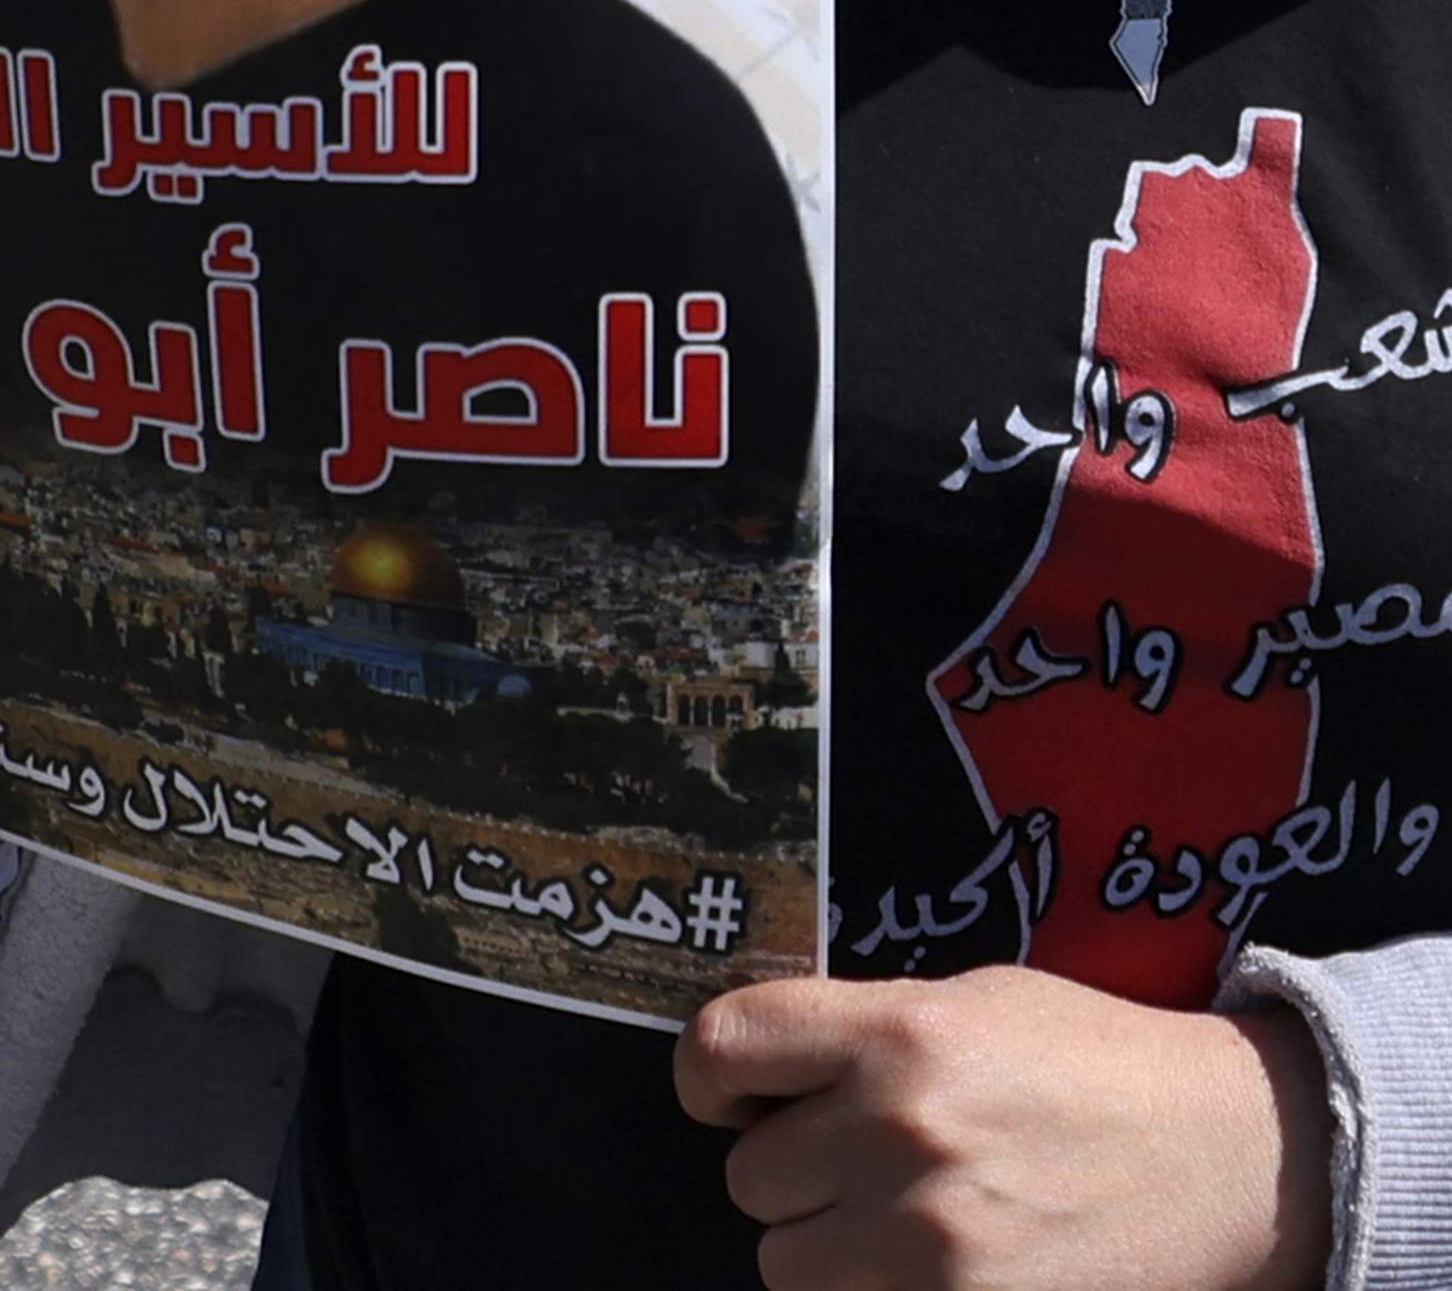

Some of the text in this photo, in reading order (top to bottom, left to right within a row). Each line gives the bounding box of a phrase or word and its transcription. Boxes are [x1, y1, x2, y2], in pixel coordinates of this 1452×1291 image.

[92, 43, 479, 203] للأسير
[21, 223, 264, 473] أبو
[320, 292, 731, 495] ناصر
[939, 362, 1177, 492] واحد
[958, 604, 1176, 711] واحد
[122, 769, 437, 900] الاحتلال
[1104, 776, 1441, 922] والعودة
